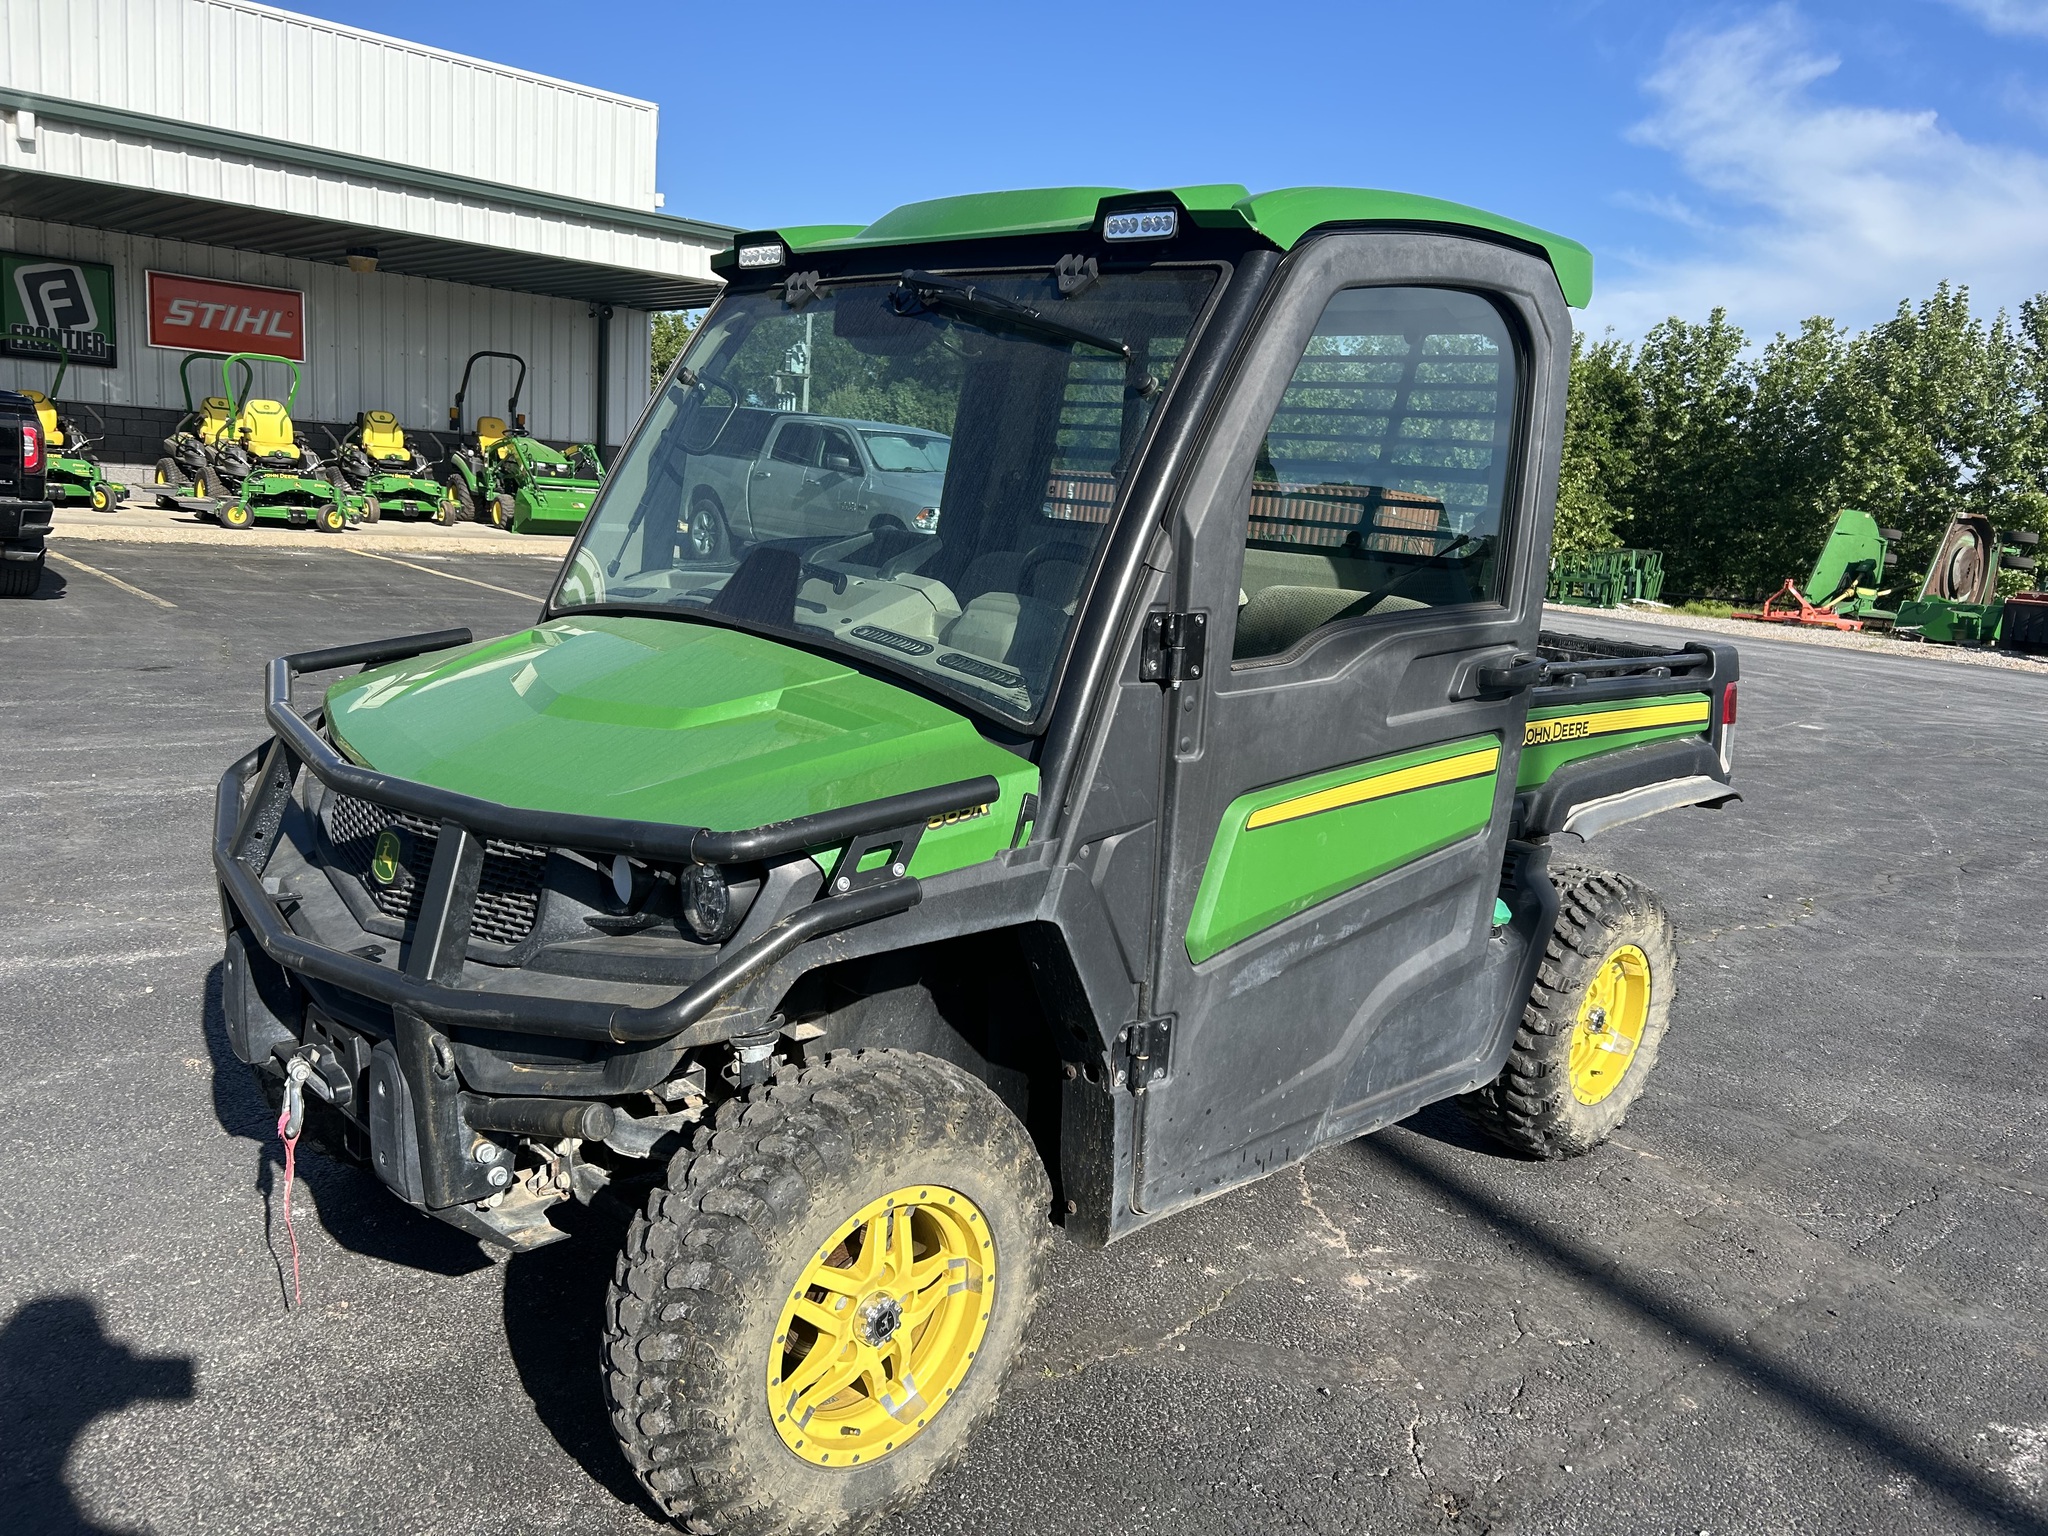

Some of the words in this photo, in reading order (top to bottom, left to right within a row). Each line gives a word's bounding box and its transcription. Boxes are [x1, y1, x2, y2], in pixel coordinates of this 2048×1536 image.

[163, 298, 293, 339] STIHL
[11, 323, 106, 354] FRONTIER
[1553, 721, 1589, 739] DEERE
